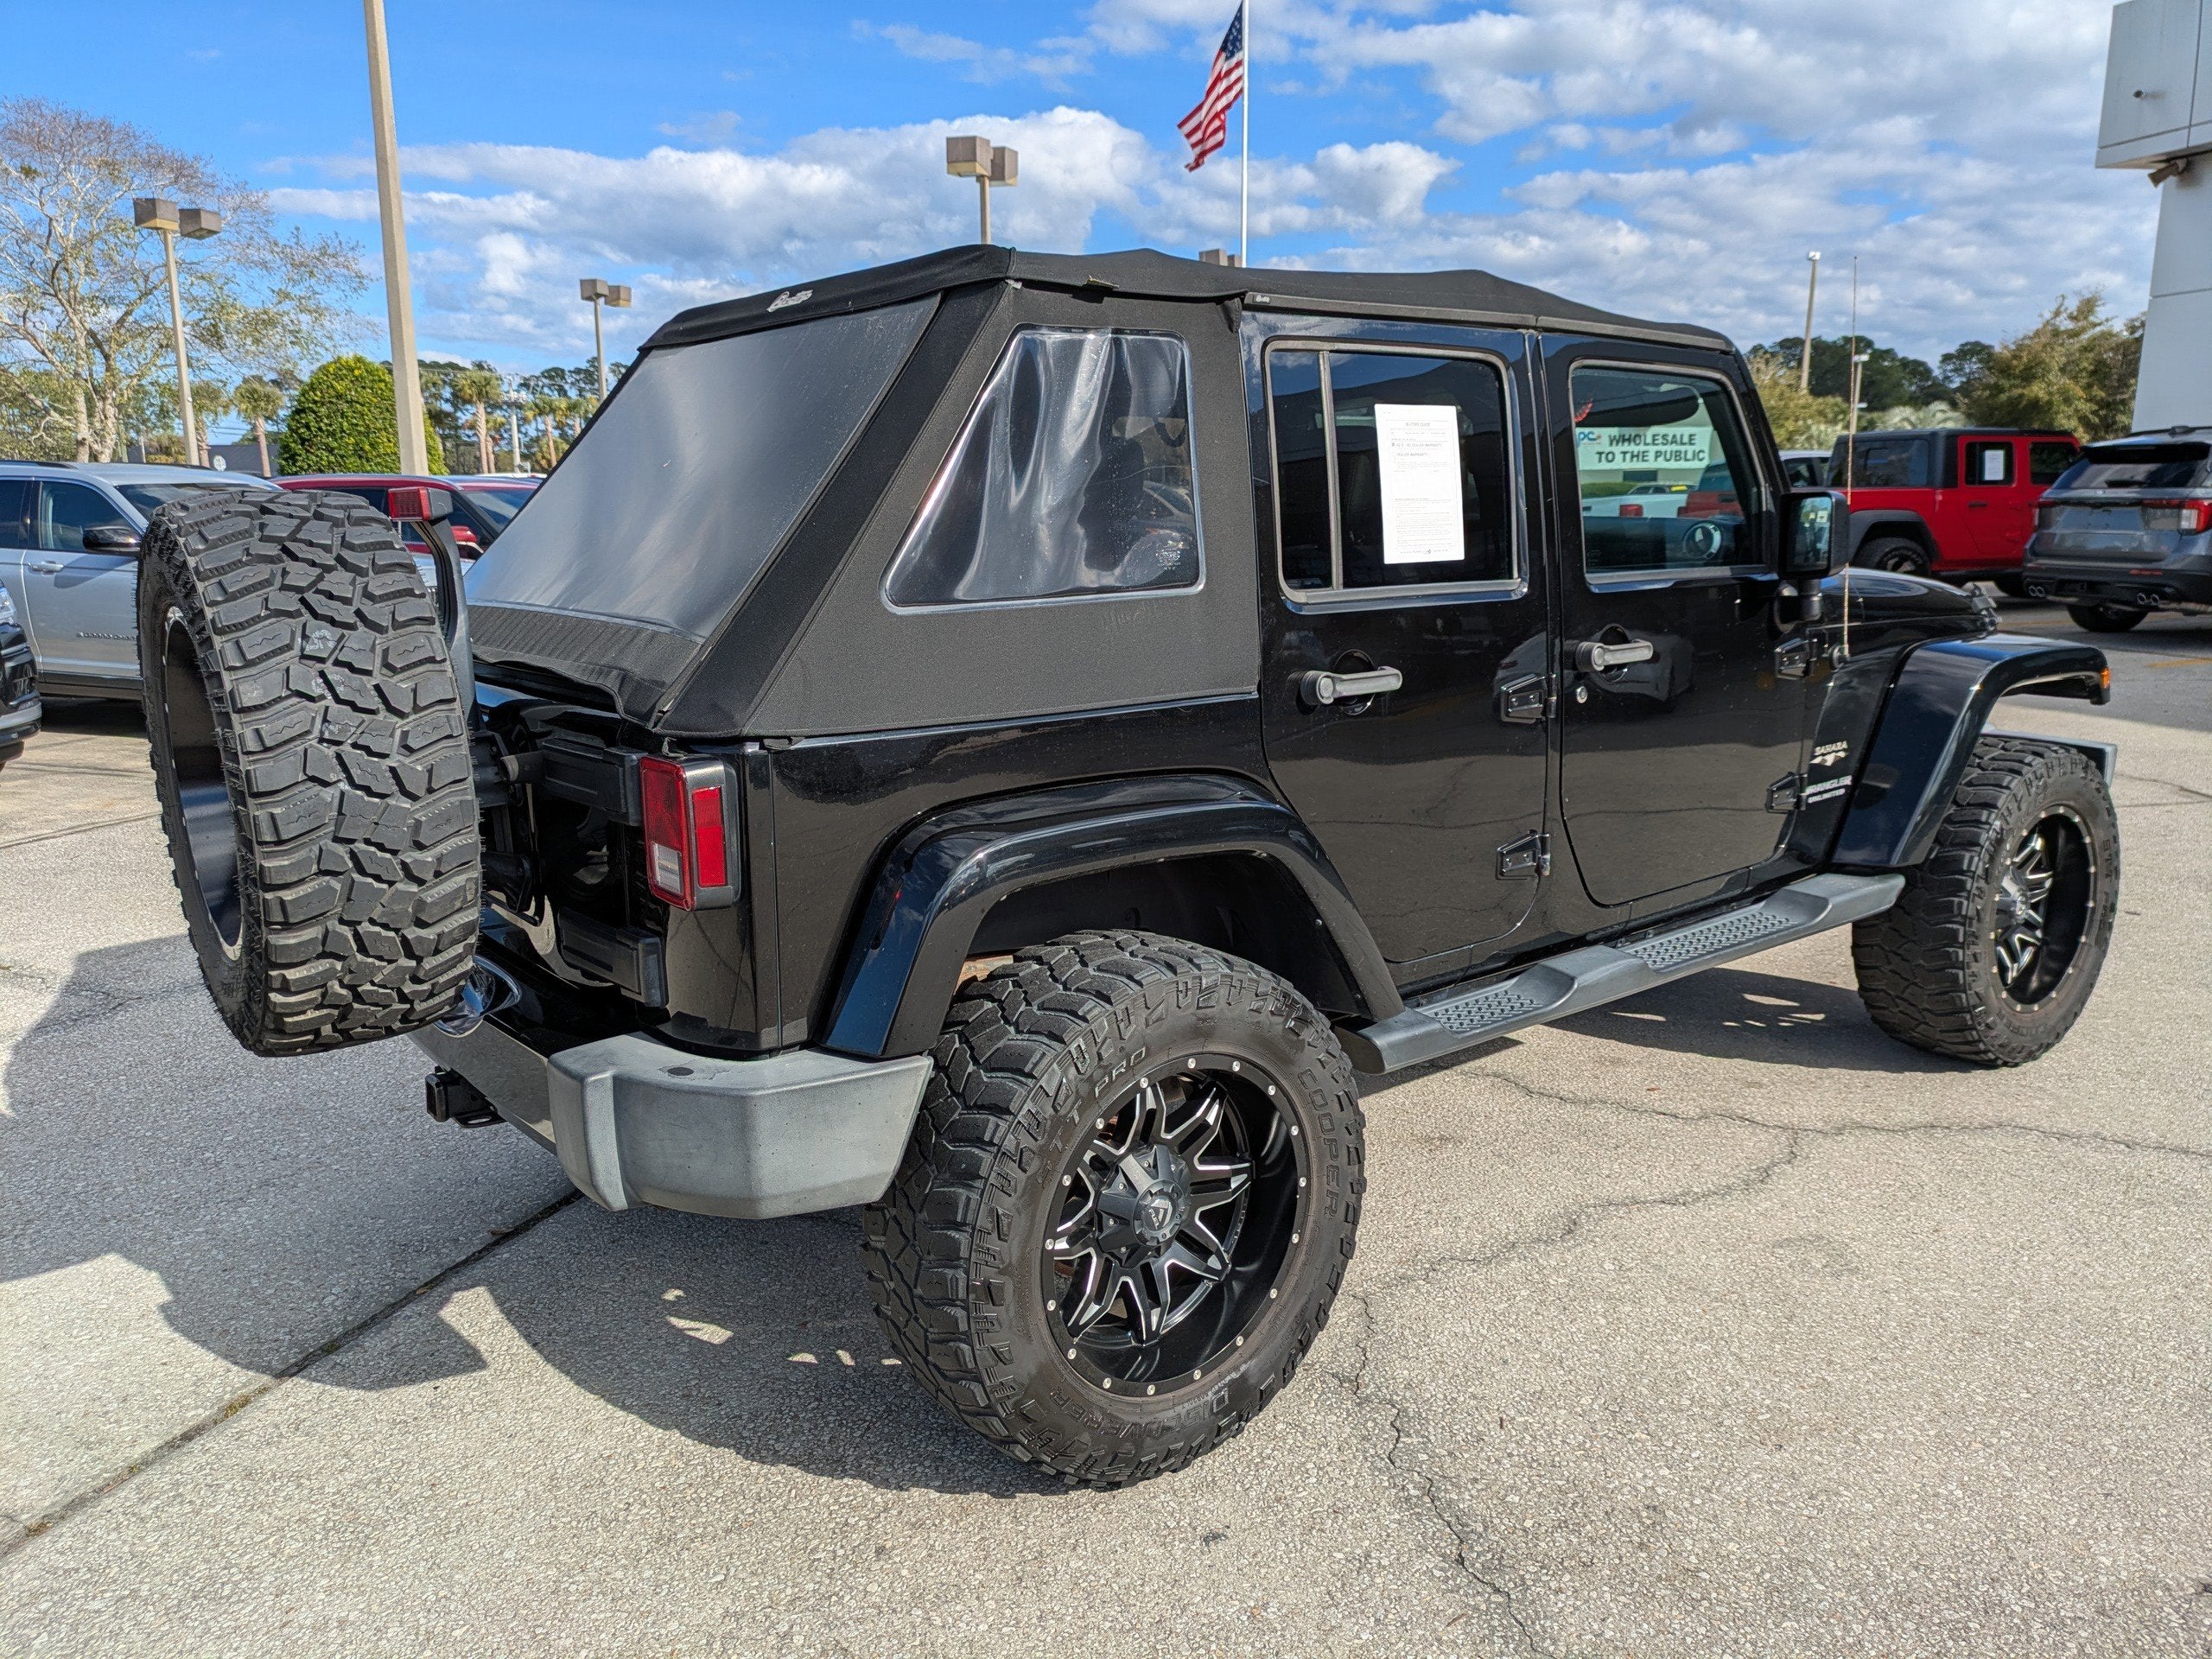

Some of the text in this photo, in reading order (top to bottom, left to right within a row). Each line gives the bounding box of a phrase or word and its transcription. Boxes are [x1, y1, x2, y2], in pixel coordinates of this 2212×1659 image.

[1596, 449, 1706, 463] TO THE PUBLIC
[1608, 433, 1697, 447] WHOLESALE
[1094, 1046, 1147, 1098] PRO
[1297, 1068, 1340, 1217] COOPER
[1049, 1386, 1230, 1439] DISCOVERER
